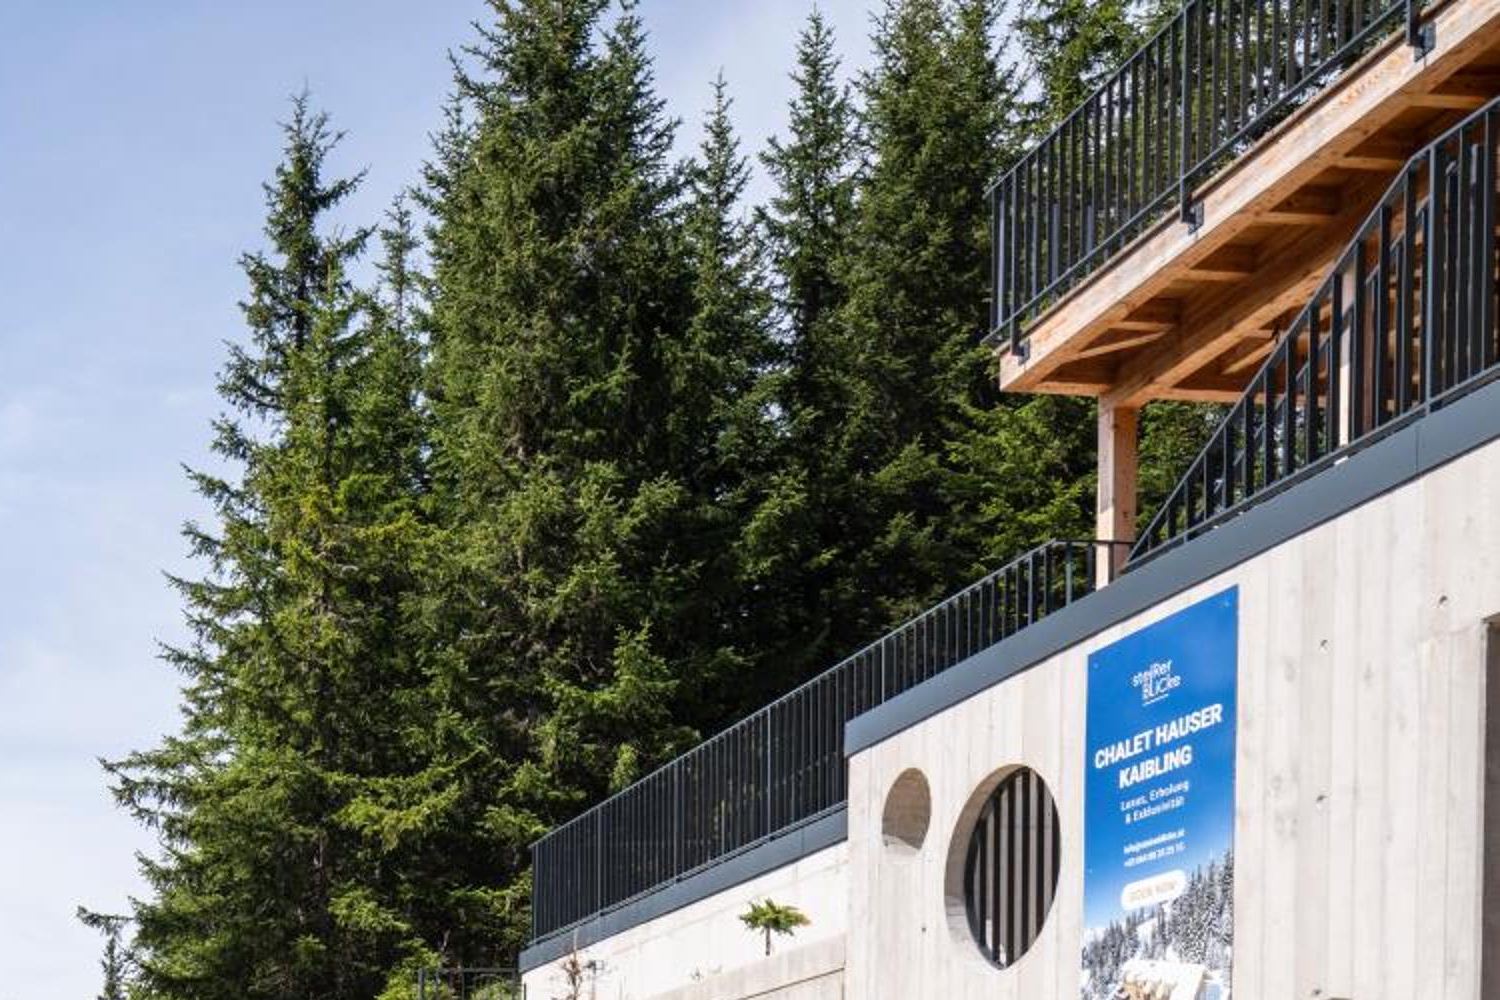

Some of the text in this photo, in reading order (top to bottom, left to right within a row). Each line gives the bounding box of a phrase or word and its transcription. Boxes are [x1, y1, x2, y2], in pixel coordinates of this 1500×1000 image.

[1095, 703, 1222, 768] CHALET HAUSER
[1119, 745, 1193, 789] KAIBLING
